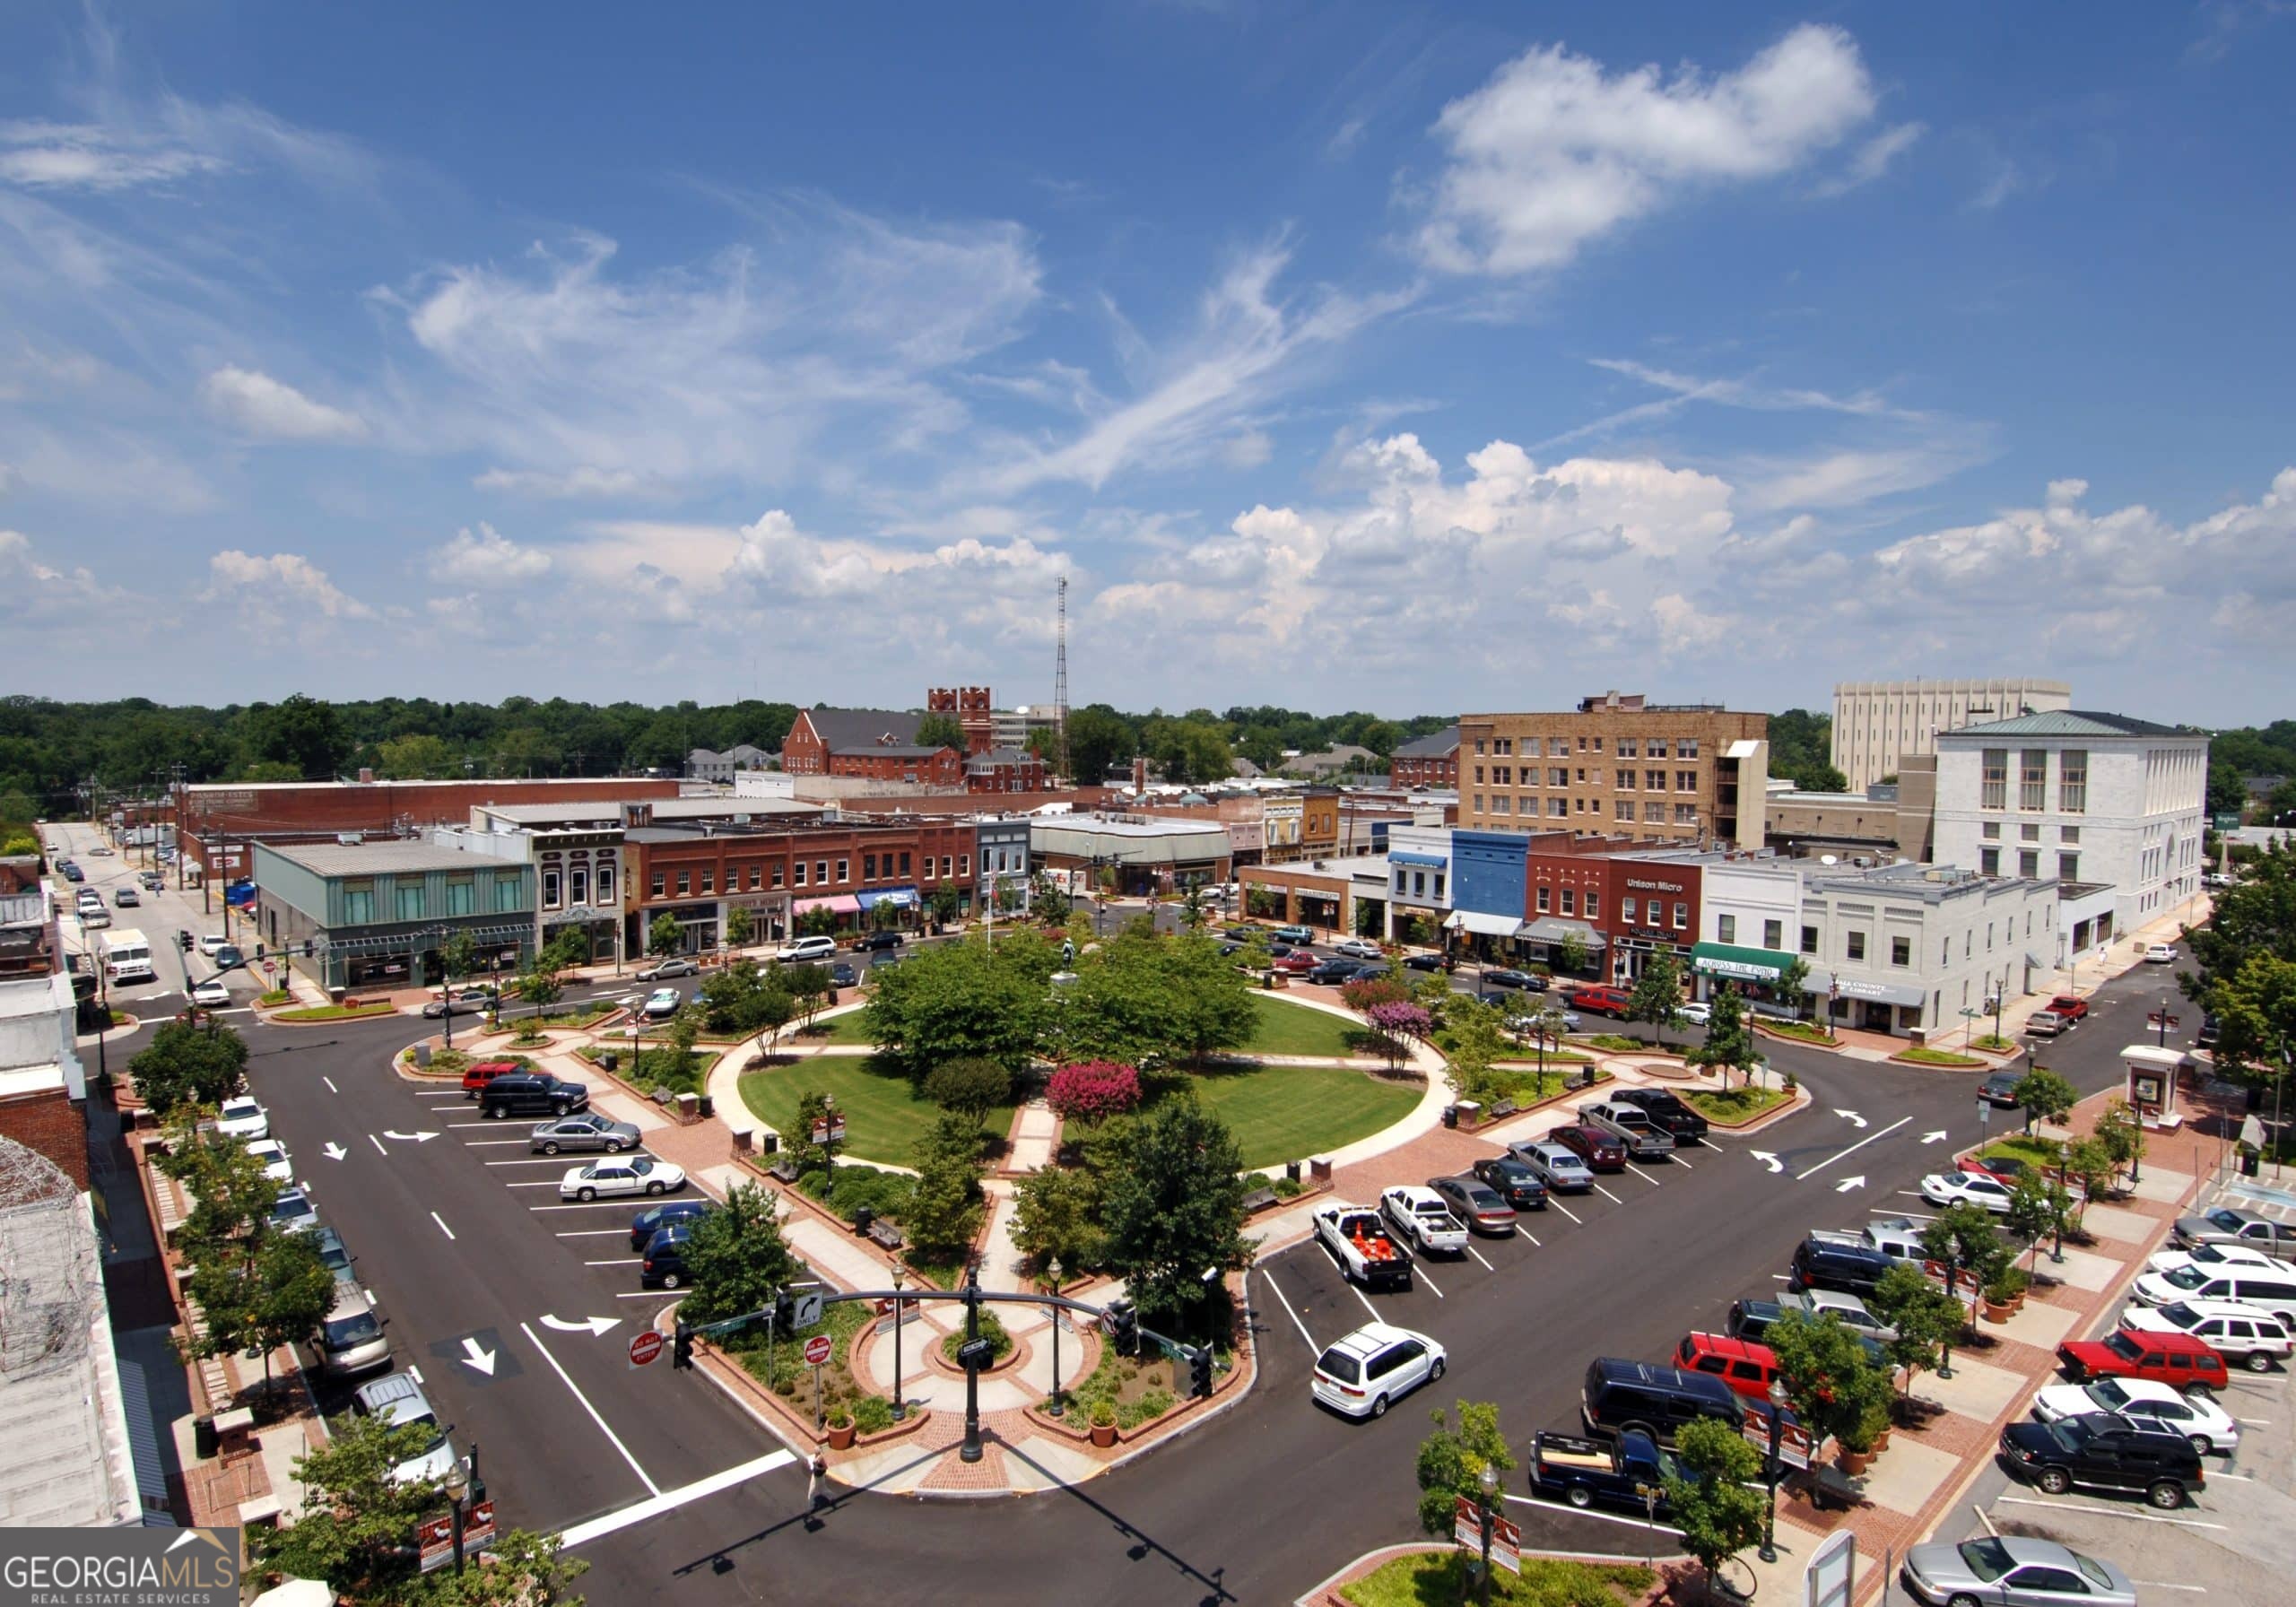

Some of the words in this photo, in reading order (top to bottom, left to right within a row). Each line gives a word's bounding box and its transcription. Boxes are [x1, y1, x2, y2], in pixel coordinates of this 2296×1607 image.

[1627, 878, 1656, 889] Unison
[1657, 882, 1683, 892] Micro
[1701, 960, 1731, 969] ACROSS
[797, 1314, 817, 1326] ONLY
[635, 1341, 644, 1349] DO
[646, 1335, 657, 1344] NOT
[637, 1349, 657, 1361] ENTER
